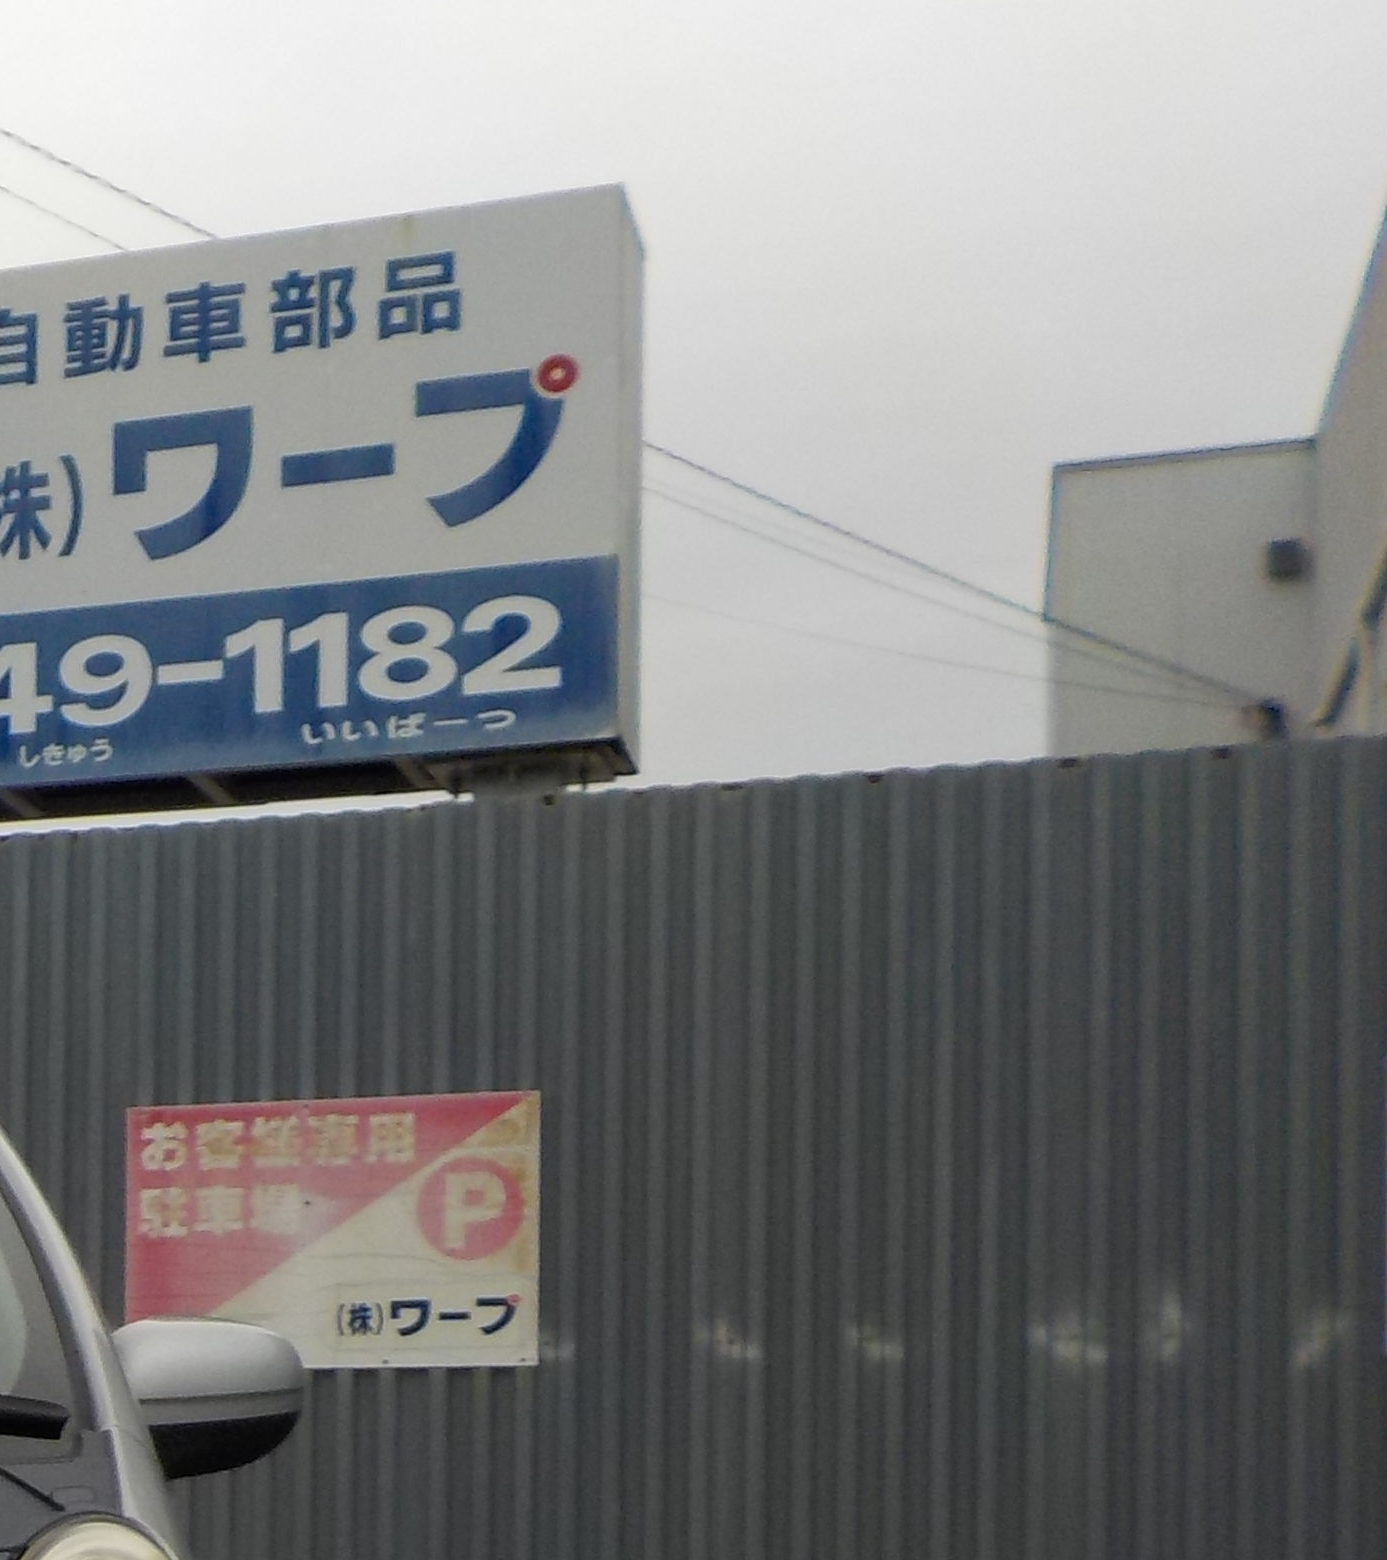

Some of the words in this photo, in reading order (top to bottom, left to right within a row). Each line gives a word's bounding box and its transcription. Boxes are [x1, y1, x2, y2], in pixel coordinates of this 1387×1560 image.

[18, 737, 114, 768] しきゅう
[336, 1293, 522, 1338] (株)ワープ
